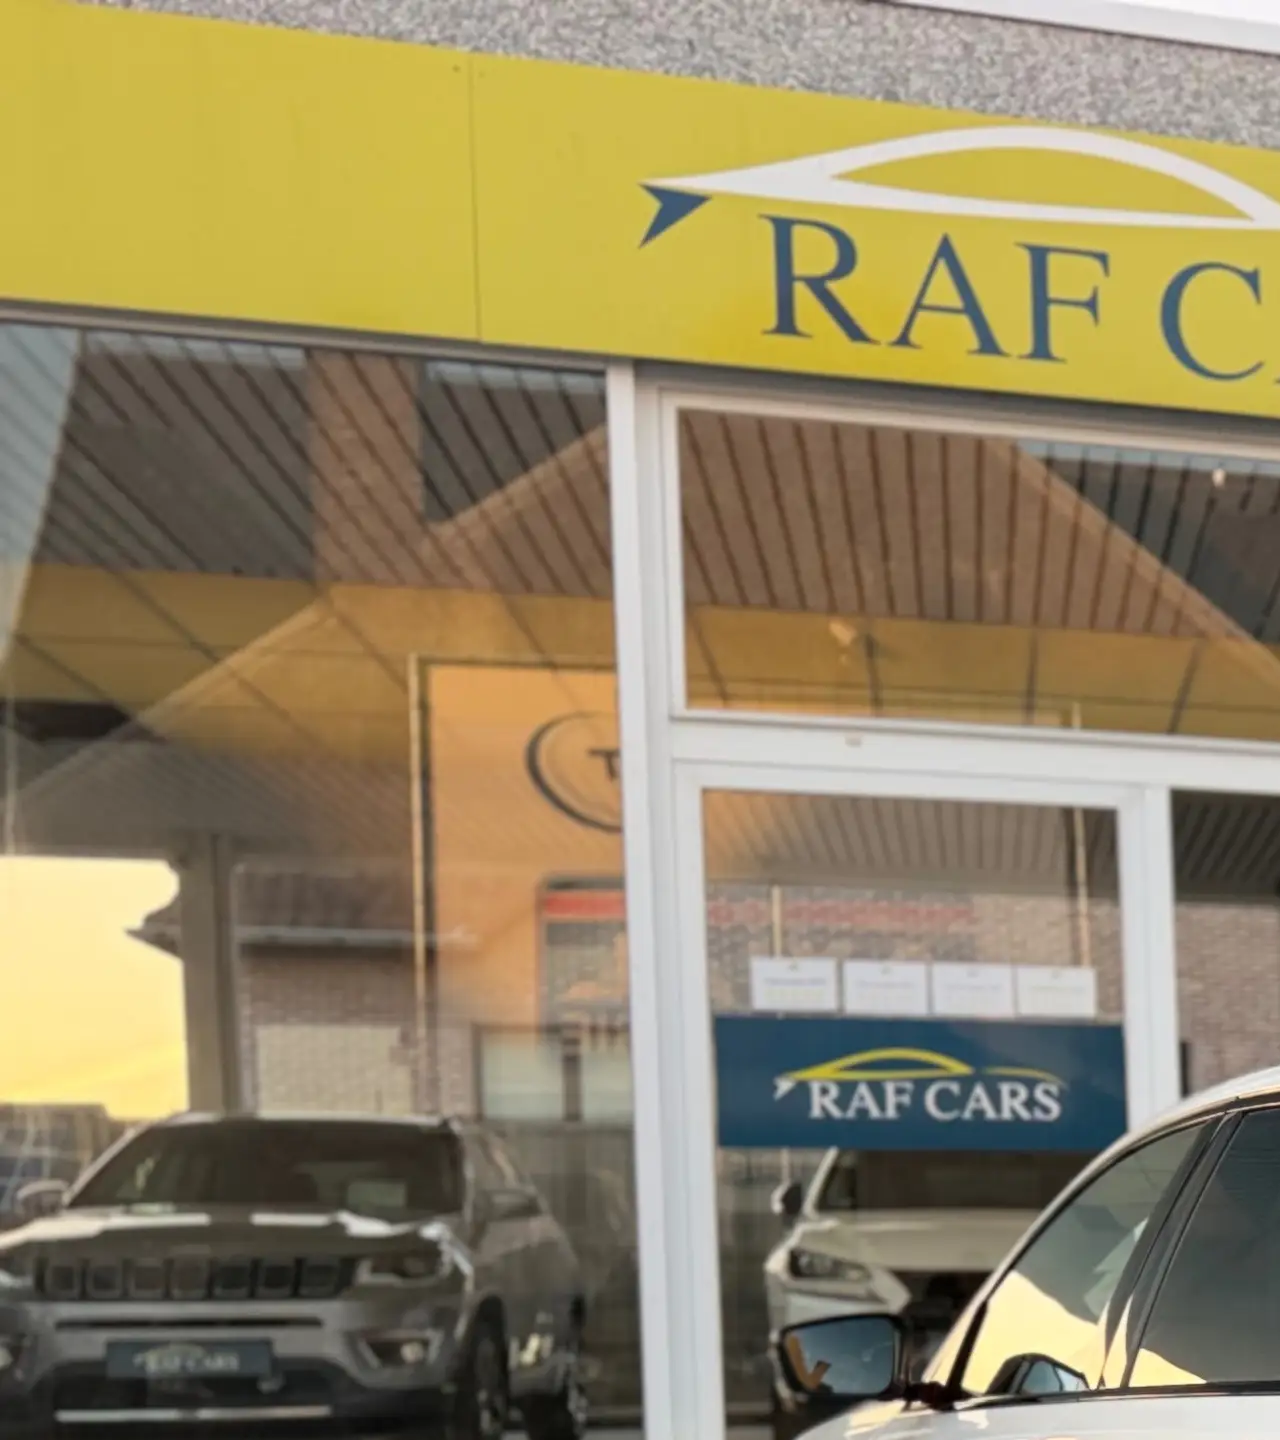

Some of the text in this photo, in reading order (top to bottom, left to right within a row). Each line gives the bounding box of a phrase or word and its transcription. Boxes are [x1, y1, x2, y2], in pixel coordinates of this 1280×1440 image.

[758, 213, 1110, 364] RAF
[808, 1081, 1062, 1122] RAF CARS
